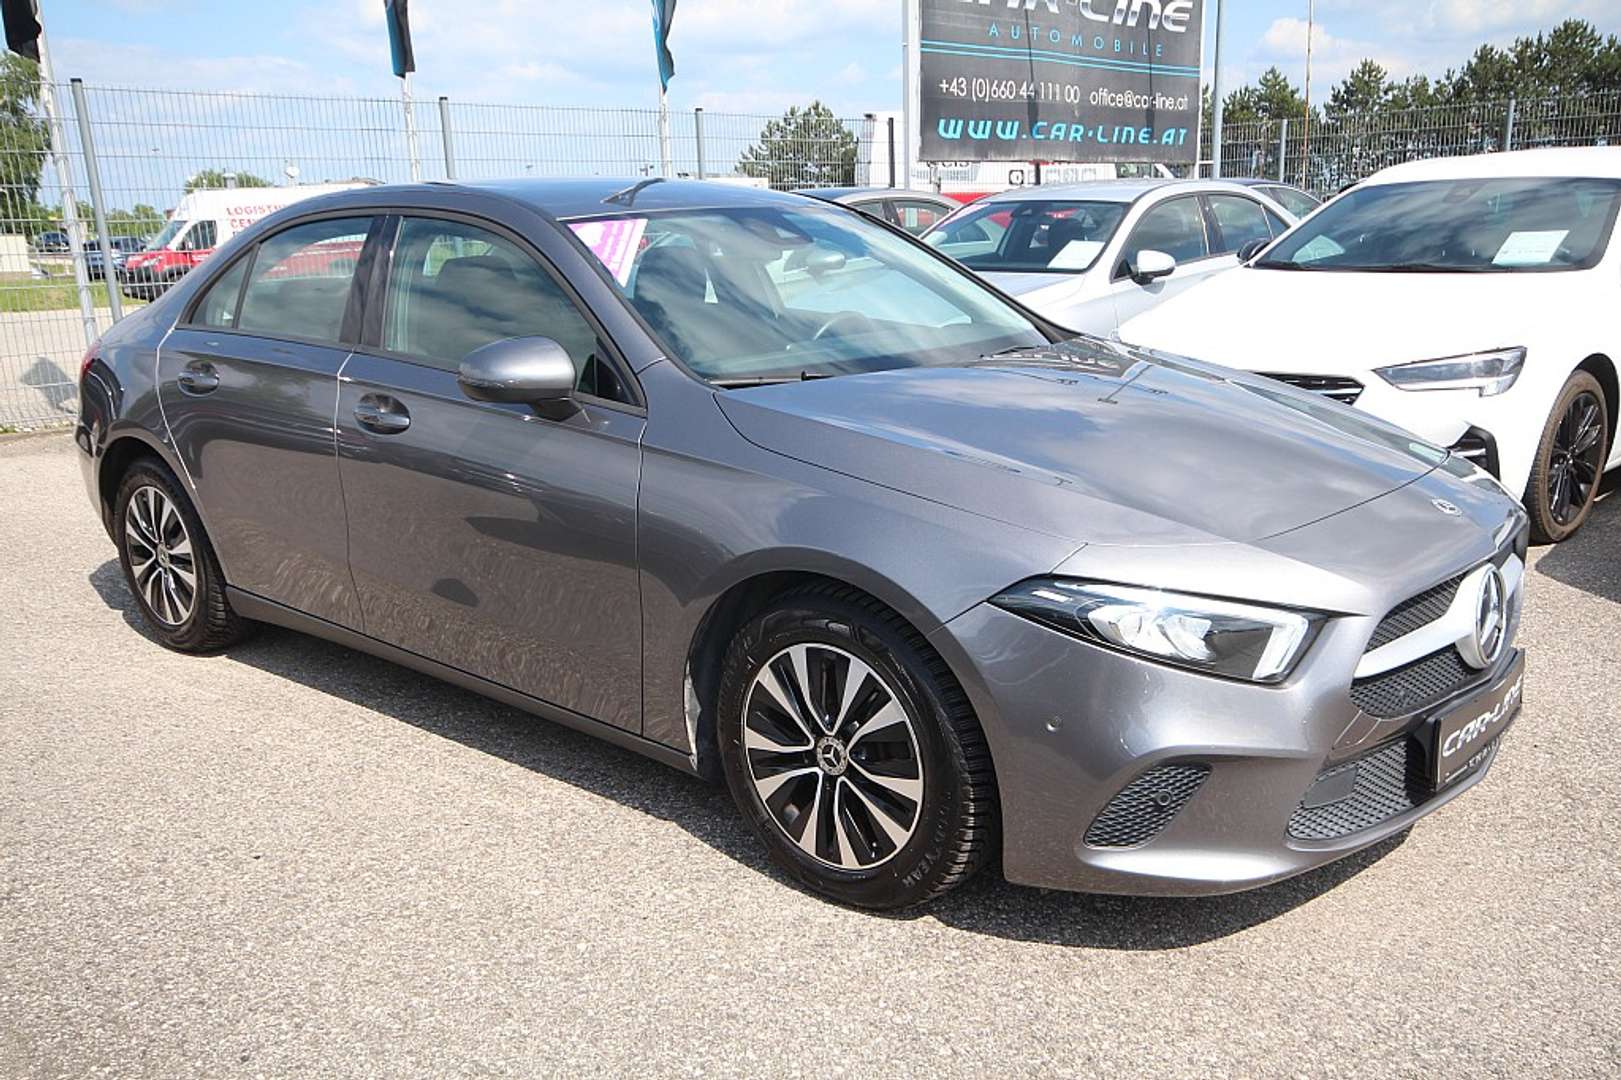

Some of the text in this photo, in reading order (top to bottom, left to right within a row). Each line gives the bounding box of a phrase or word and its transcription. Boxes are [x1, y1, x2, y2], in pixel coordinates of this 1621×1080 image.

[987, 22, 1163, 56] AUTOMOBILE
[939, 77, 968, 97] +43
[971, 77, 1017, 103] (0)660
[1064, 84, 1081, 104] 00
